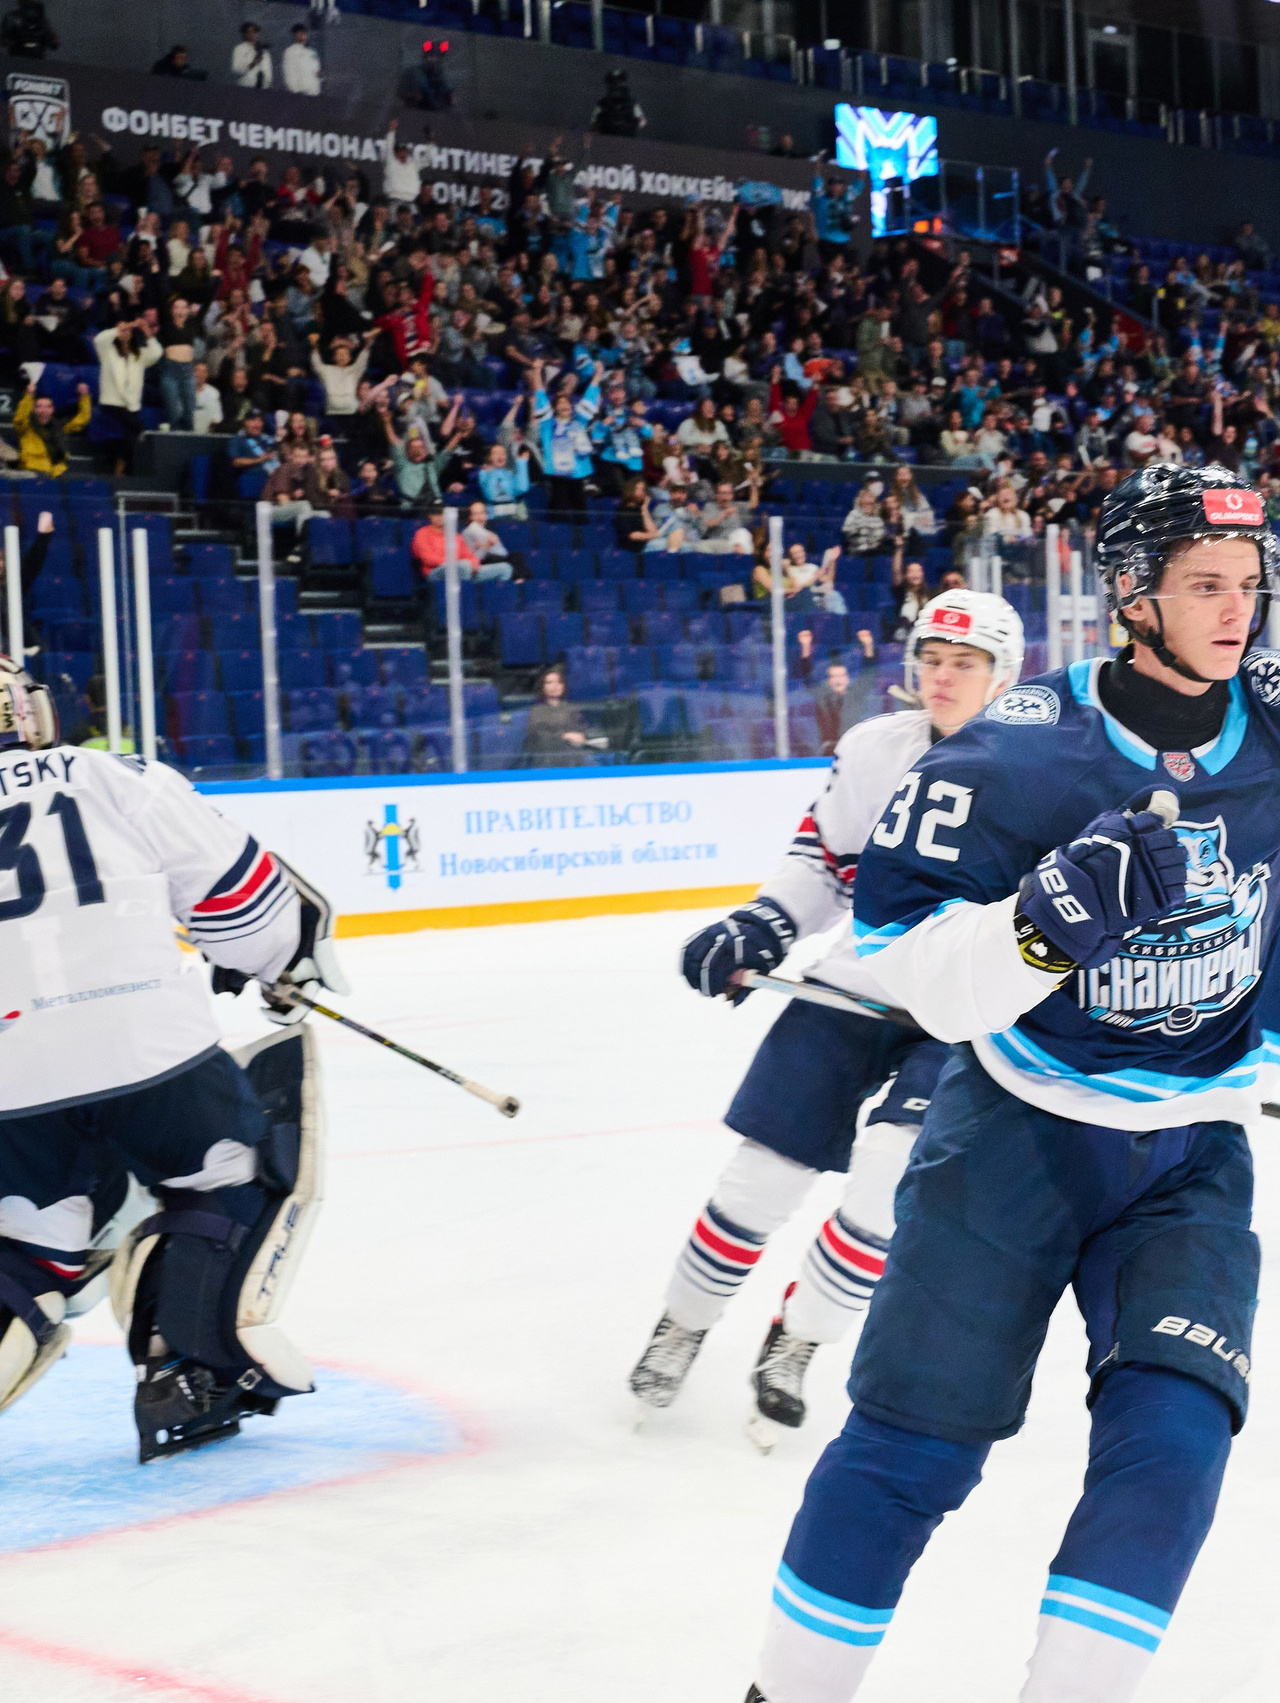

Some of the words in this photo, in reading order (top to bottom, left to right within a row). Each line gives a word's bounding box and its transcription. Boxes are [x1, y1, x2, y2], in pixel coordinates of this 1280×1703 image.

[101, 106, 224, 144] ФОНБЕТ
[228, 121, 388, 162] ЧЕМПИОНАТ
[464, 800, 693, 835] ПРАВИТЕЛЬСТВО
[871, 771, 975, 862] 32
[0, 791, 108, 921] 31
[439, 844, 623, 876] Новосибирской
[632, 841, 718, 863] области
[1129, 930, 1233, 956] СИБИРСКИЕ
